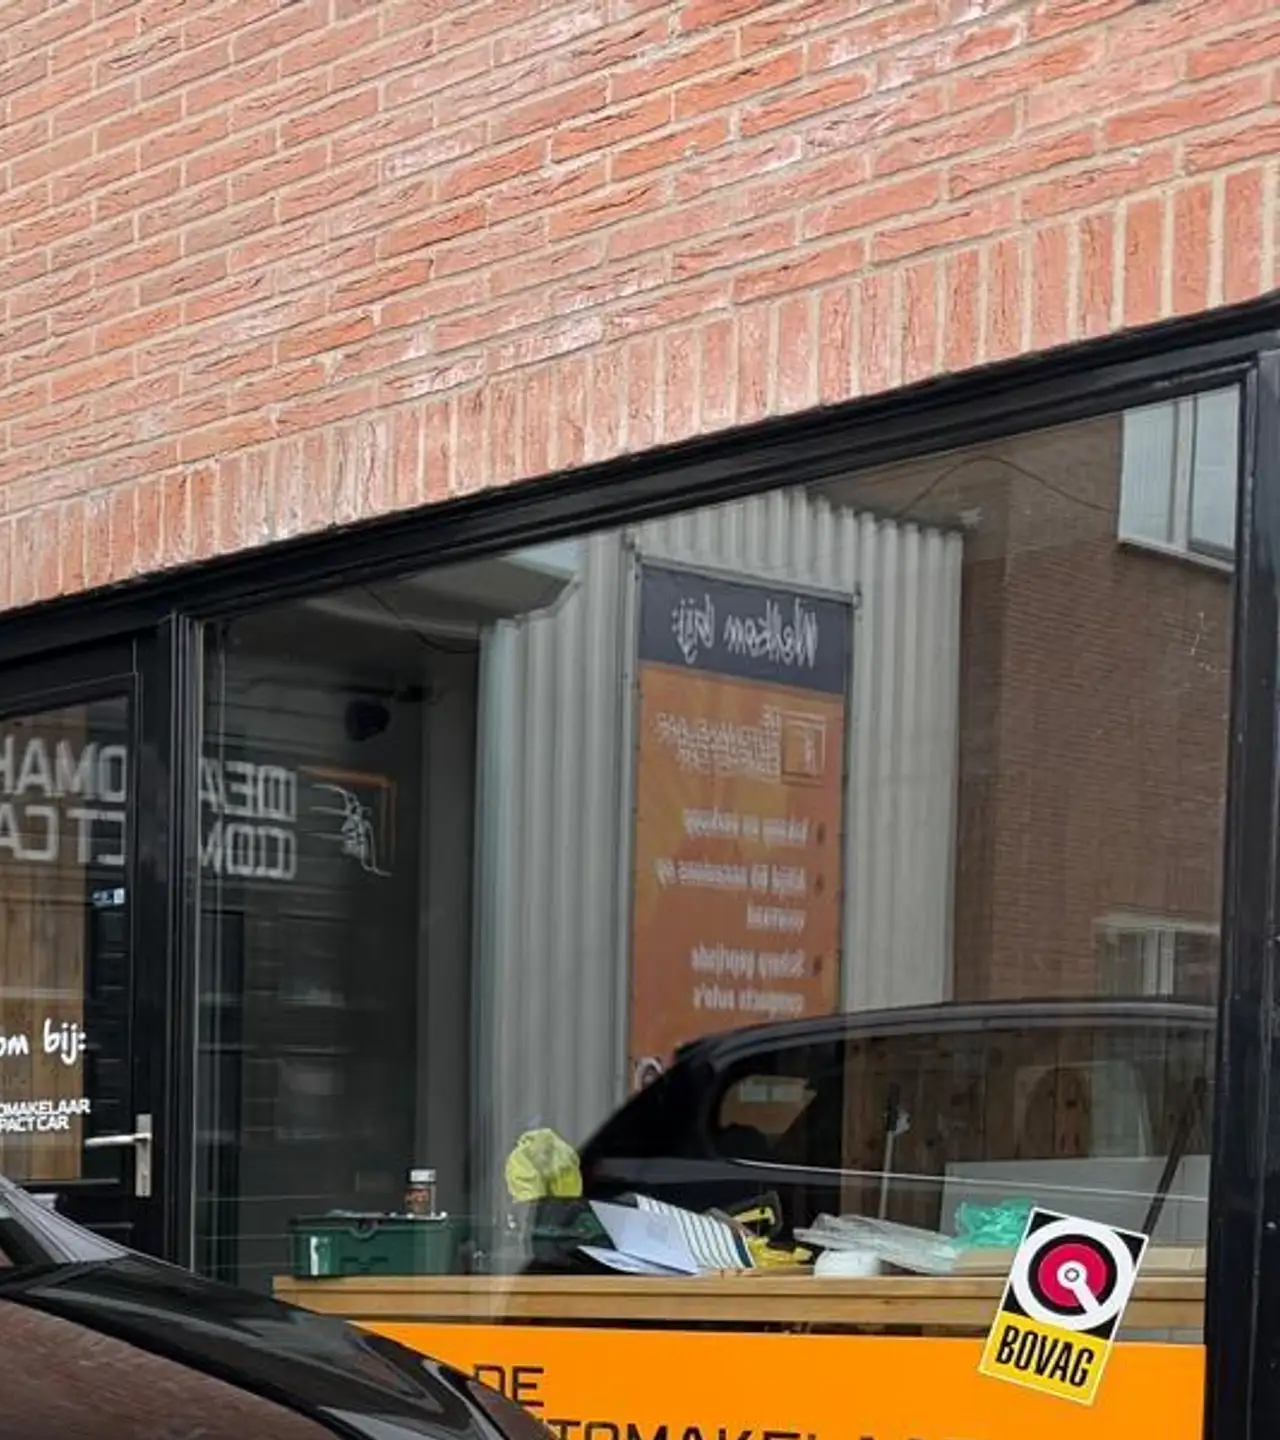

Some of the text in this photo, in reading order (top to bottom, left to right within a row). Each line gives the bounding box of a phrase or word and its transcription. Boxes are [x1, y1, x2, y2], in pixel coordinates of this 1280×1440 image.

[43, 1017, 87, 1066] bij:
[37, 1115, 70, 1132] CAR
[995, 1325, 1094, 1387] BOVAG
[474, 1364, 544, 1408] DE
